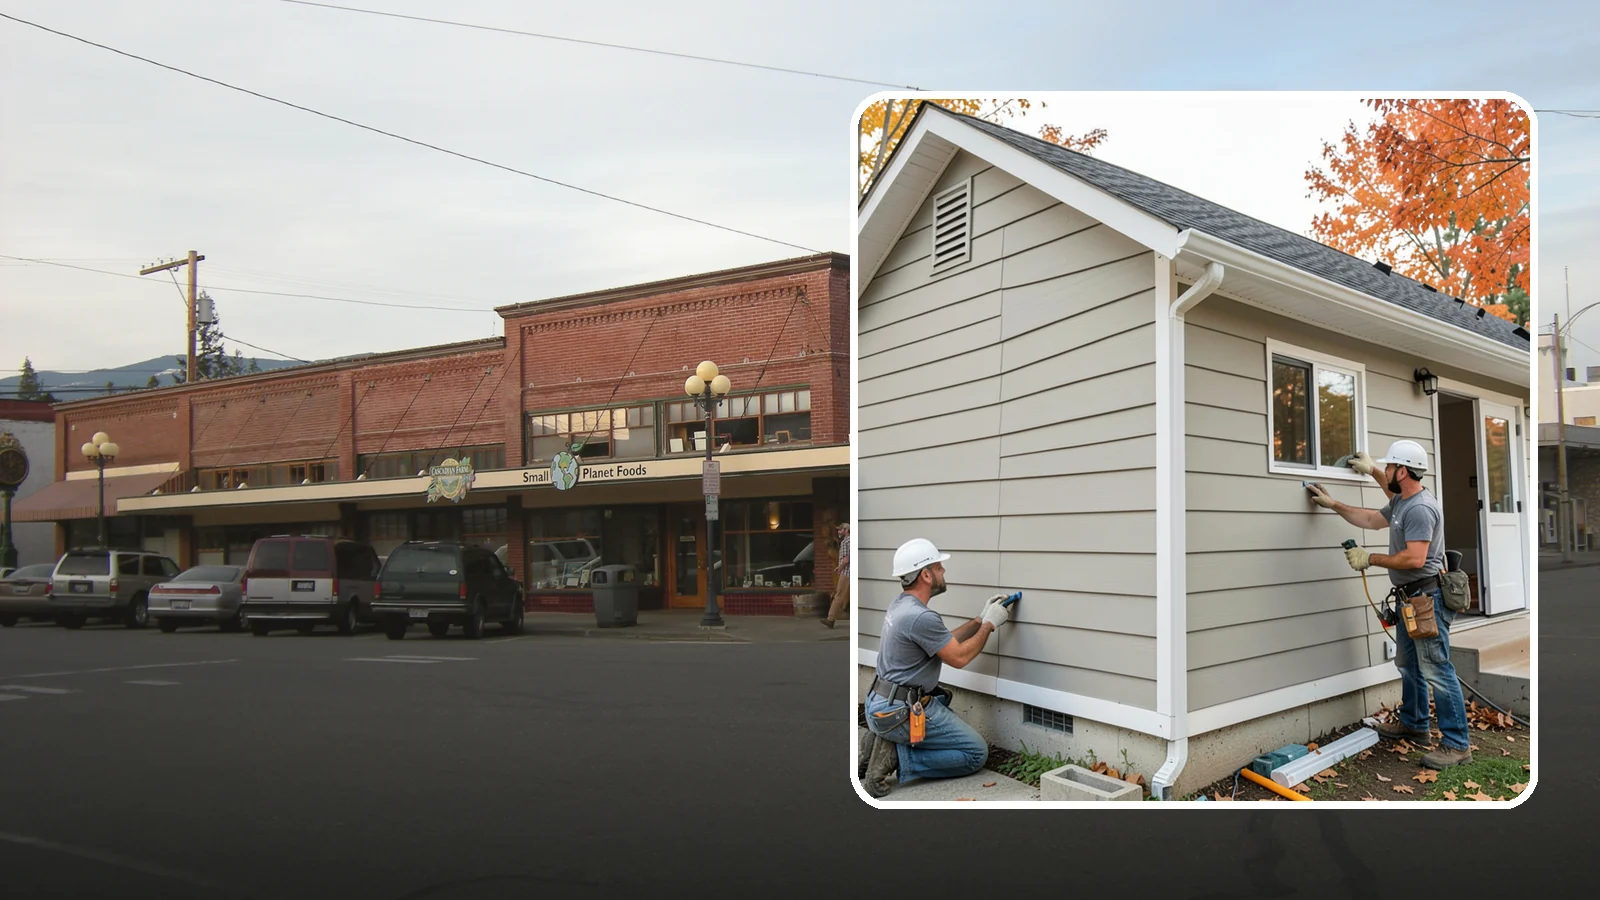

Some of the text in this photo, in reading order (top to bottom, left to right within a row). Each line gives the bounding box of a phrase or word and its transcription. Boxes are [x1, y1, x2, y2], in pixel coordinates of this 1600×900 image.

[523, 465, 647, 483] Small Planet Foods
